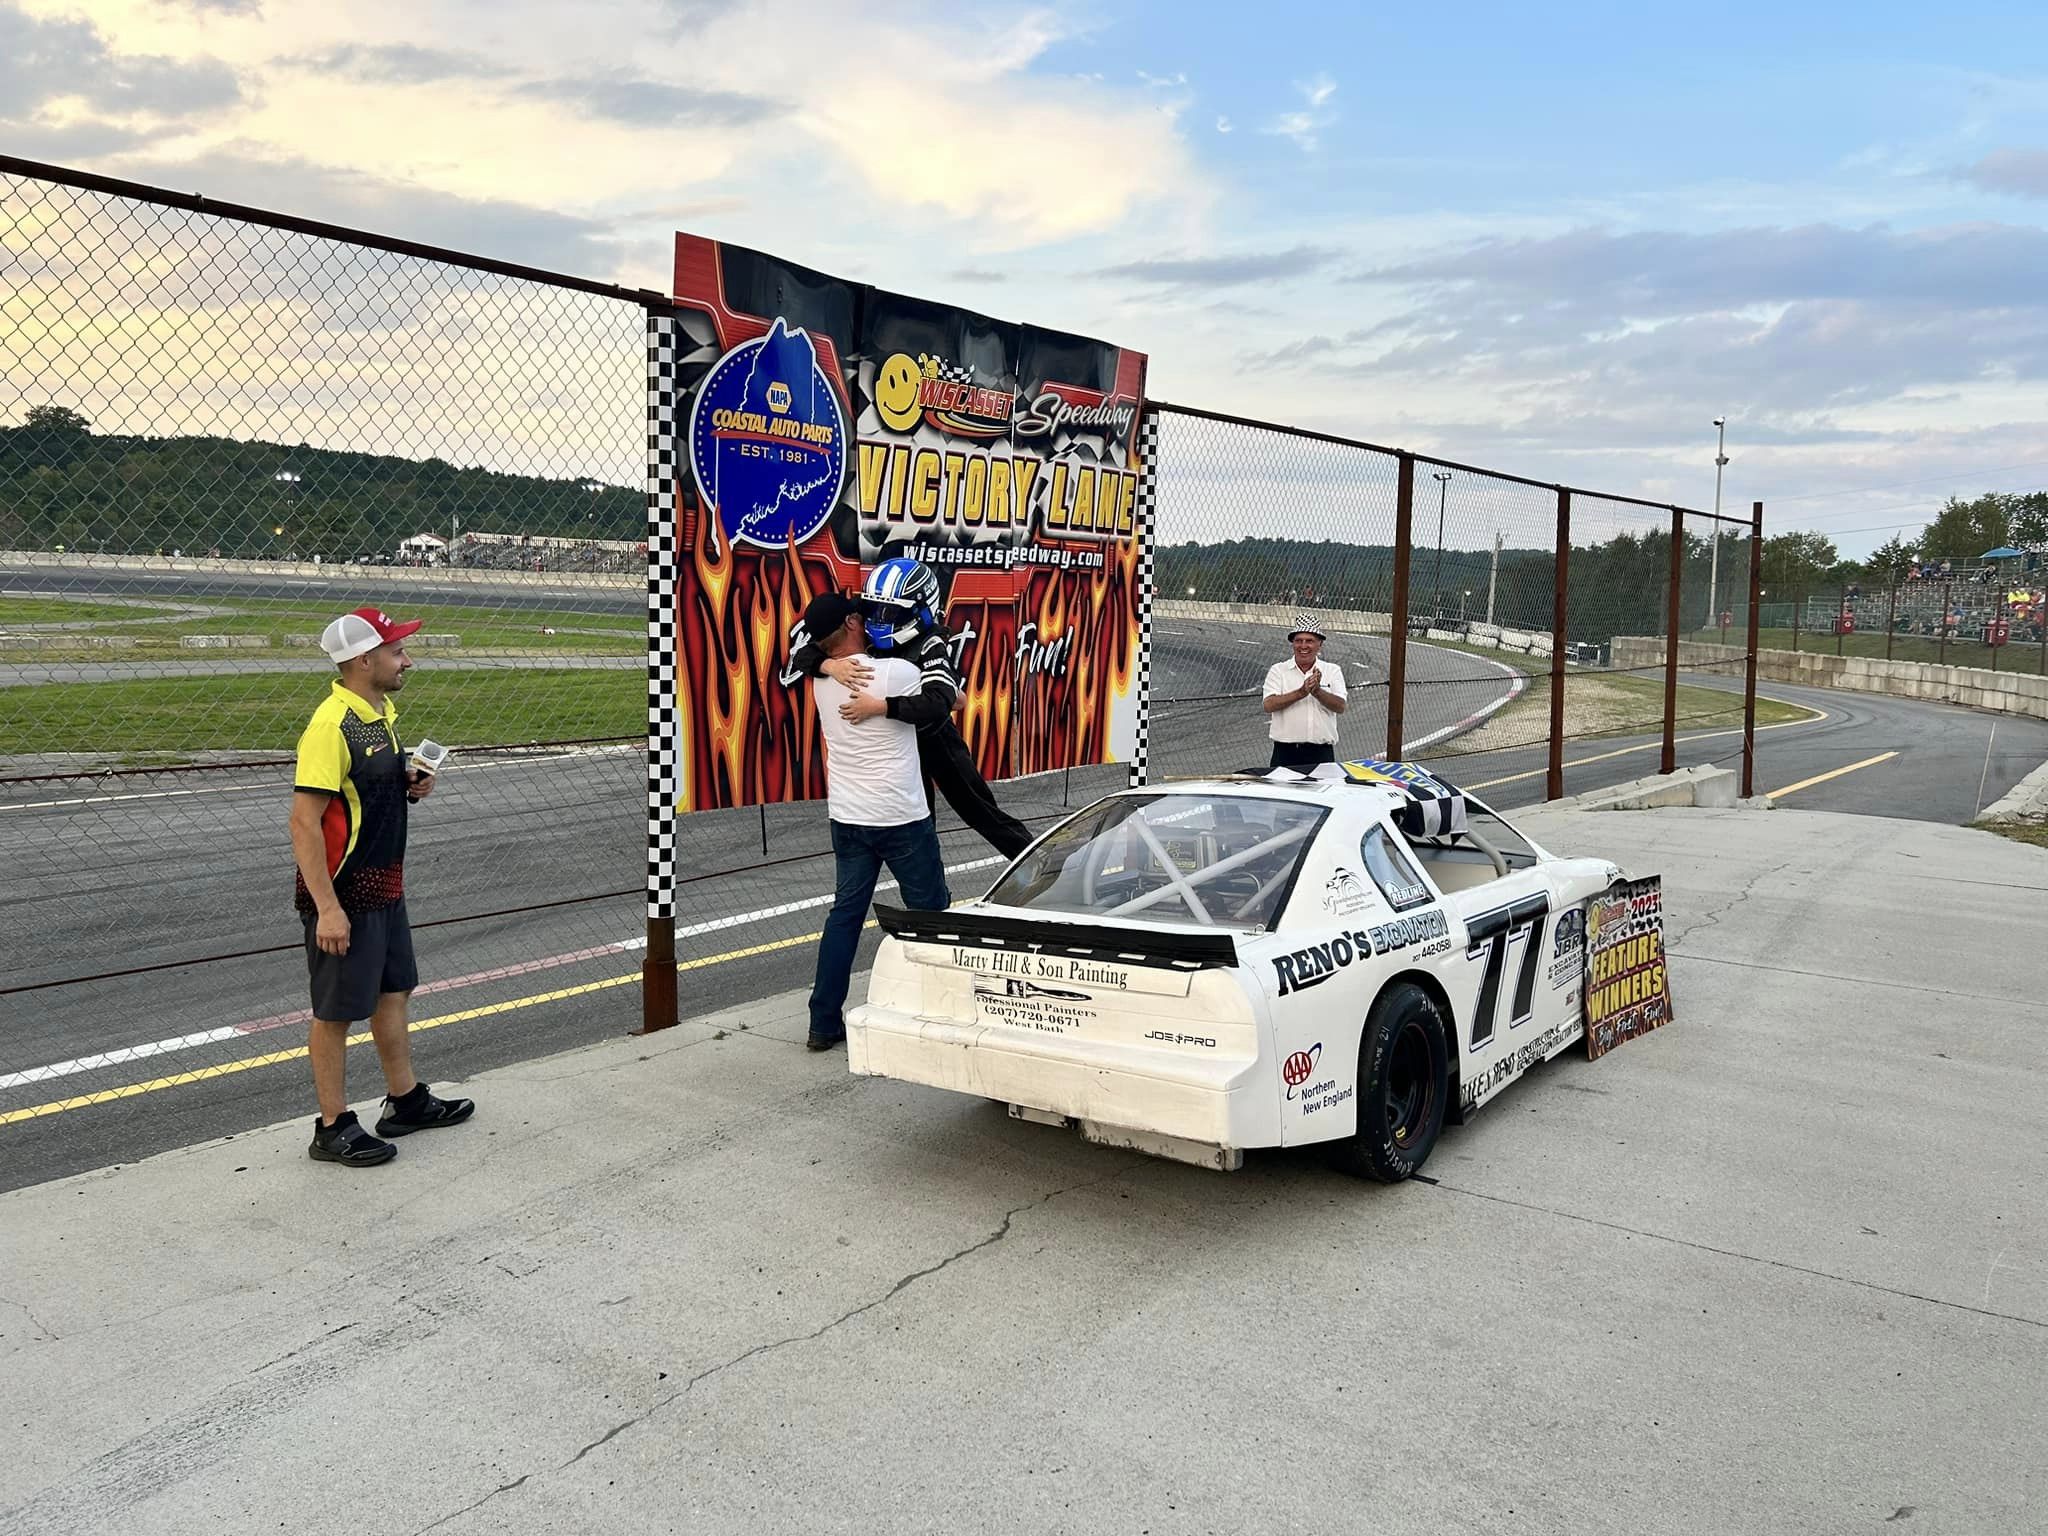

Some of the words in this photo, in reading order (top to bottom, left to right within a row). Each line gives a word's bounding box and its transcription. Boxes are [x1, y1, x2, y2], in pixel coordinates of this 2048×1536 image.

[770, 389, 789, 406] NAPA
[919, 376, 1014, 421] WISCASSET
[1016, 393, 1134, 437] Speedway
[712, 408, 768, 437] COASTAL
[768, 417, 801, 438] AUTO
[801, 422, 833, 444] PARTS
[741, 444, 773, 459] EST.
[780, 449, 808, 465] 1981
[857, 442, 1042, 528] VICTORY
[1047, 461, 1138, 536] LANE
[903, 542, 1103, 569] wiscassetspeedway.com
[1015, 622, 1073, 682] Fun!
[1631, 894, 1659, 919] 2023
[952, 947, 989, 972] Marty
[992, 952, 1018, 973] Hill
[1020, 955, 1032, 975] &
[1037, 957, 1063, 979] Son
[1069, 961, 1129, 990] Painting
[1271, 930, 1373, 996] RENO'S
[1368, 909, 1449, 956] EXCAVATION
[1592, 932, 1660, 985] FEATURE
[1463, 890, 1552, 1053] 77
[1044, 1003, 1097, 1018] Painters
[1590, 965, 1664, 1023] WINNERS
[1003, 1018, 1032, 1029] West
[1036, 1022, 1064, 1034] Bath
[1284, 1053, 1311, 1084] AAA
[1301, 1079, 1336, 1101] Northern
[1303, 1101, 1322, 1116] New
[1323, 1085, 1353, 1108] England
